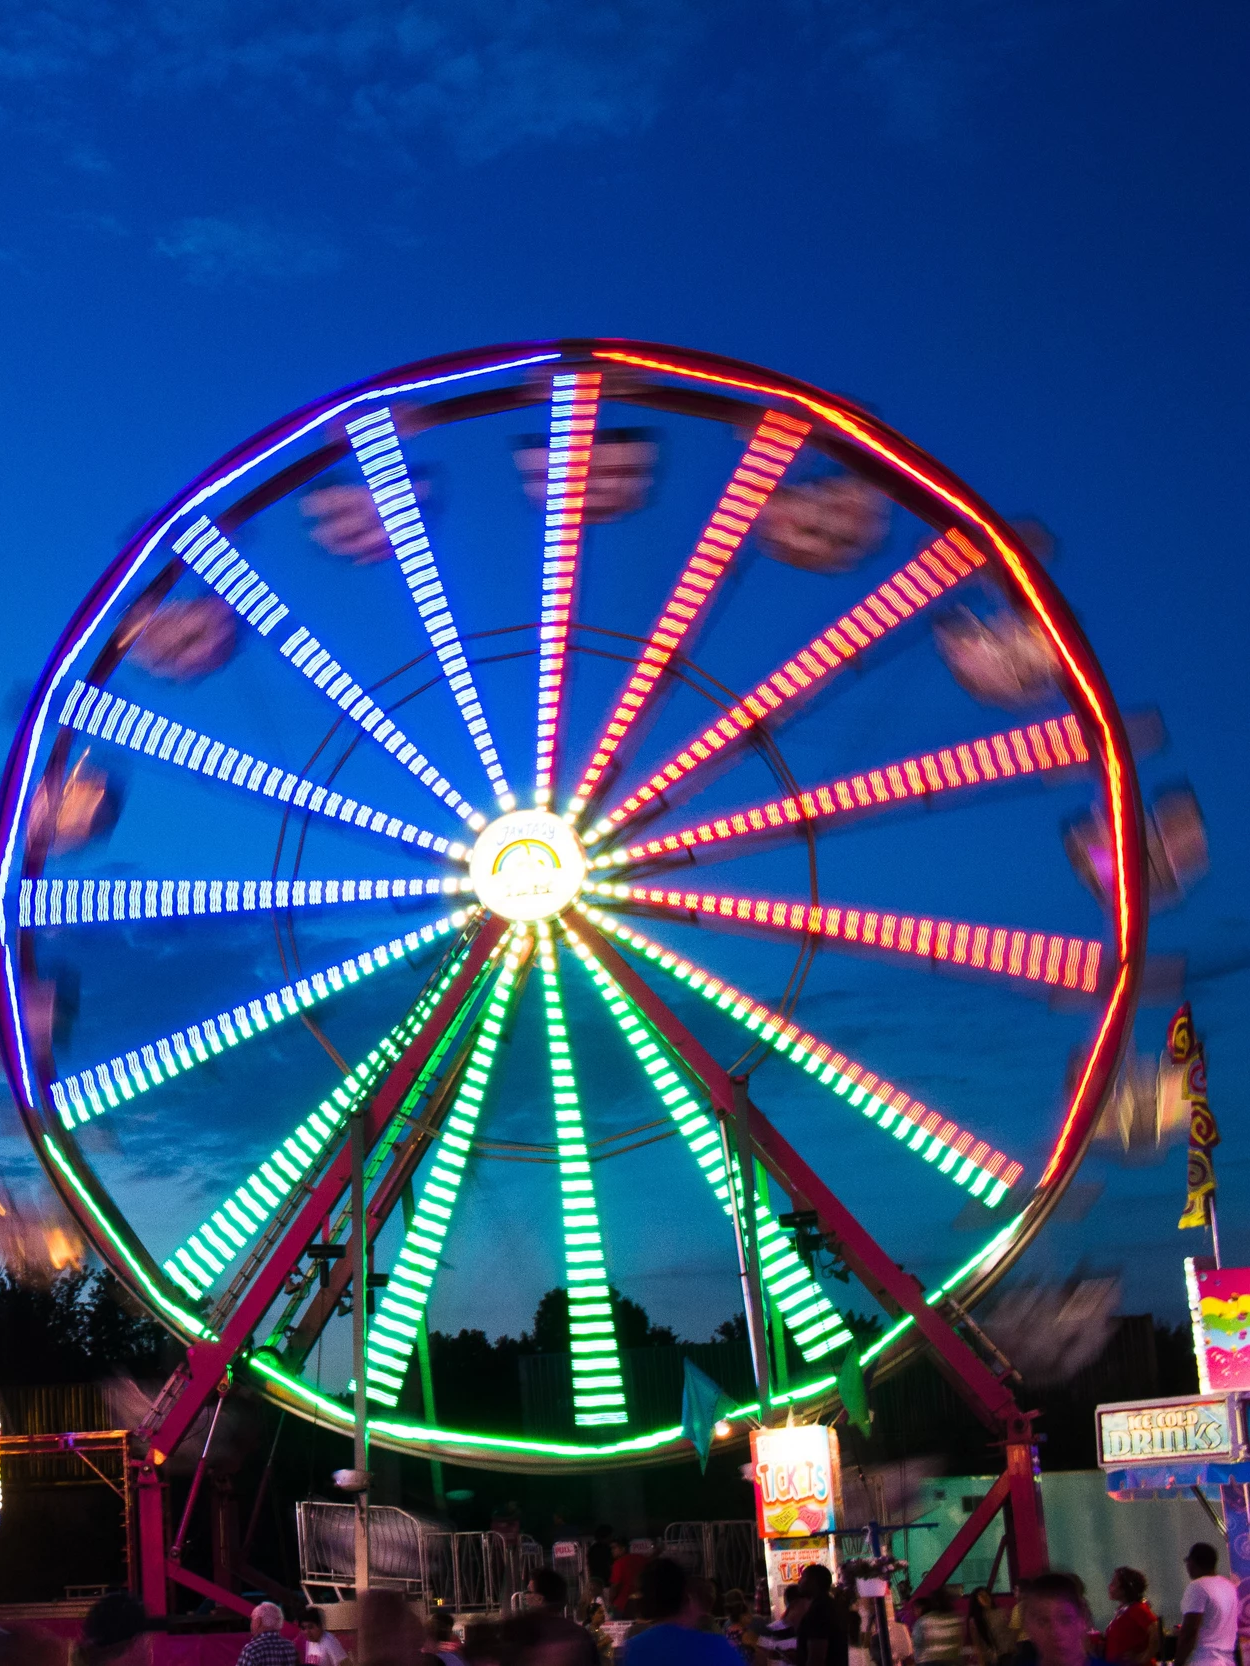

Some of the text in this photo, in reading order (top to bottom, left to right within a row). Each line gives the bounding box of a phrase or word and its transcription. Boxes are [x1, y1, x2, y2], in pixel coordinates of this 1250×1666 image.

[1127, 1410, 1198, 1429] ICE COLD
[1109, 1421, 1222, 1456] DRINKS
[758, 1460, 827, 1500] TICKETS
